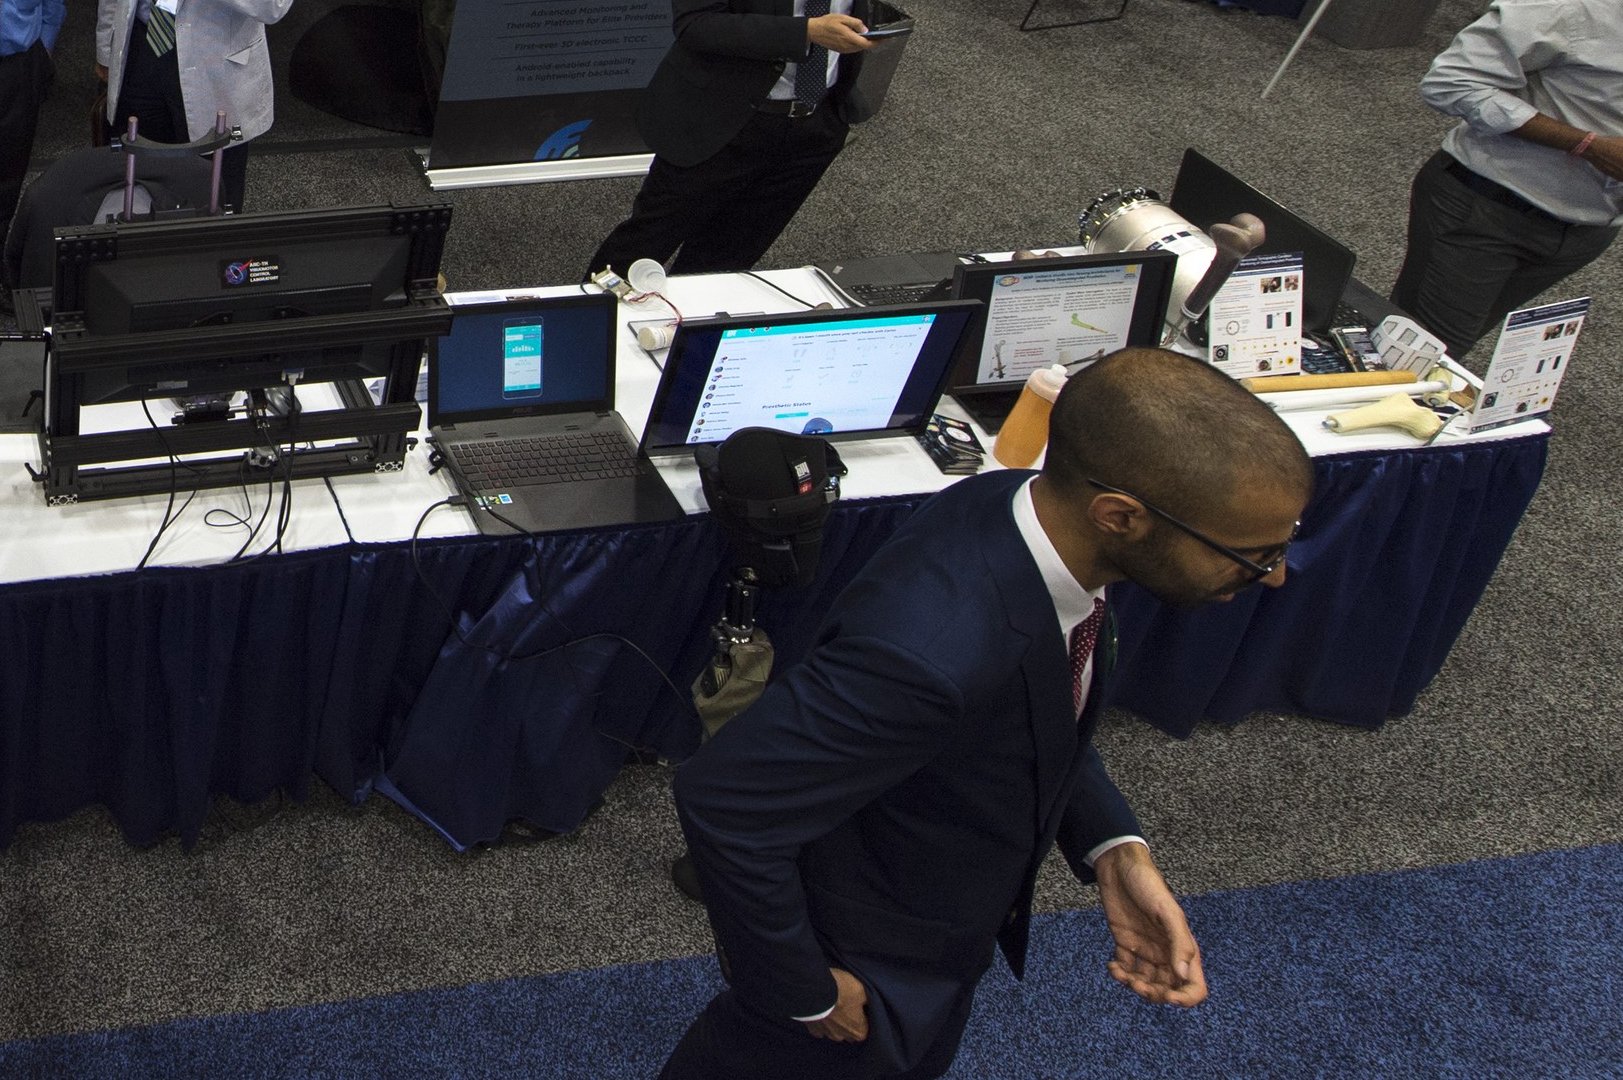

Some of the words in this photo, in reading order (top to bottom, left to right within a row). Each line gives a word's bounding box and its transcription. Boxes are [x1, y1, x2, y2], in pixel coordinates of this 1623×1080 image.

[530, 8, 578, 18] Advanced
[578, 4, 628, 15] Monitoring
[630, 2, 648, 11] and
[506, 20, 542, 31] Therapy
[544, 18, 584, 28] Platform
[586, 17, 600, 25] for
[624, 12, 668, 22] Providers
[514, 42, 558, 52] First-ever
[576, 37, 620, 47] electronic
[622, 35, 648, 43] TCCC
[516, 60, 591, 72] Android-enabled
[592, 58, 637, 69] capability
[516, 74, 526, 82] in
[534, 71, 586, 83] lightweight
[588, 69, 630, 78] backpack
[761, 402, 792, 410] Prosthetic
[792, 401, 812, 409] Status
